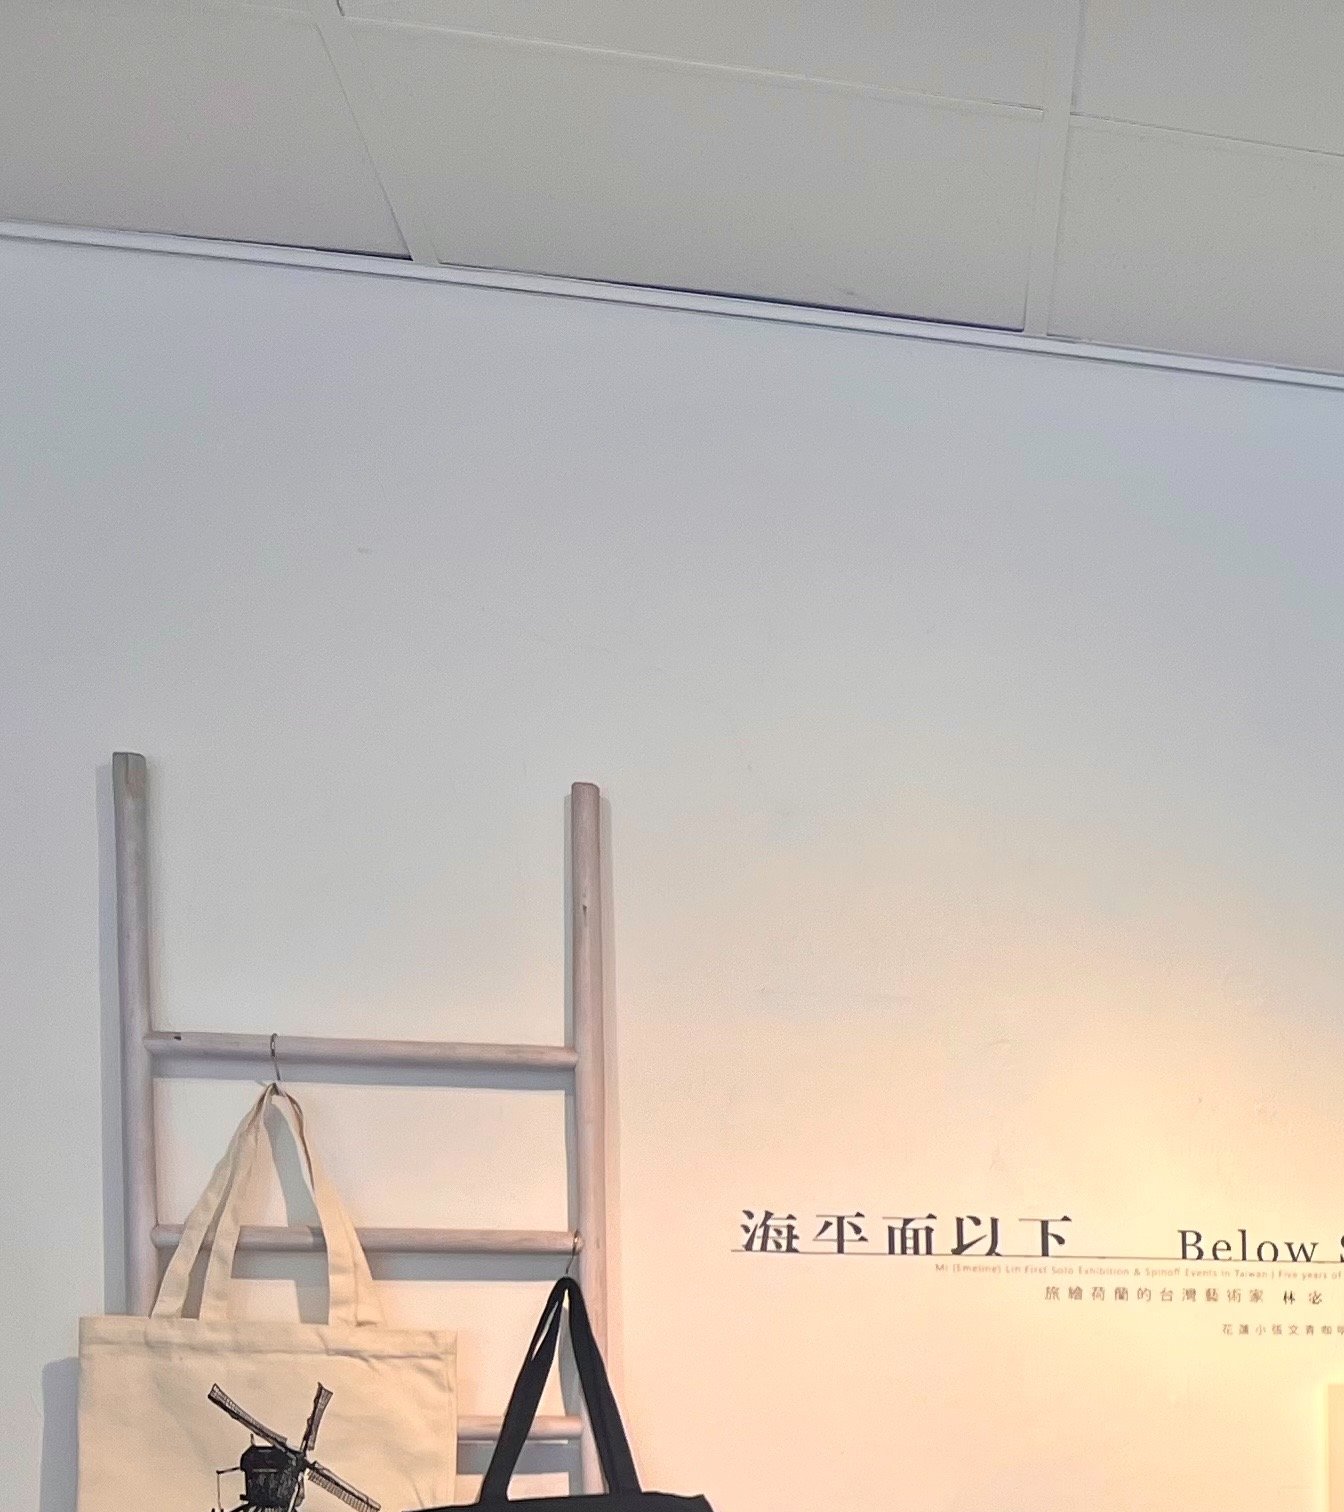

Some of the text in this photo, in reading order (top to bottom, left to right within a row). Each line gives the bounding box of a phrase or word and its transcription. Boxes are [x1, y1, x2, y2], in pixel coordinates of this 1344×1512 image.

[738, 1209, 1073, 1257] 海平面以下
[1176, 1228, 1320, 1263] Below
[1078, 1266, 1130, 1277] Exhibition
[1185, 1267, 1218, 1278] Events
[1221, 1268, 1230, 1278] in
[1234, 1269, 1268, 1280] Taiwan
[1278, 1270, 1299, 1281] Five
[1301, 1272, 1329, 1283] years
[1331, 1271, 1342, 1281] of
